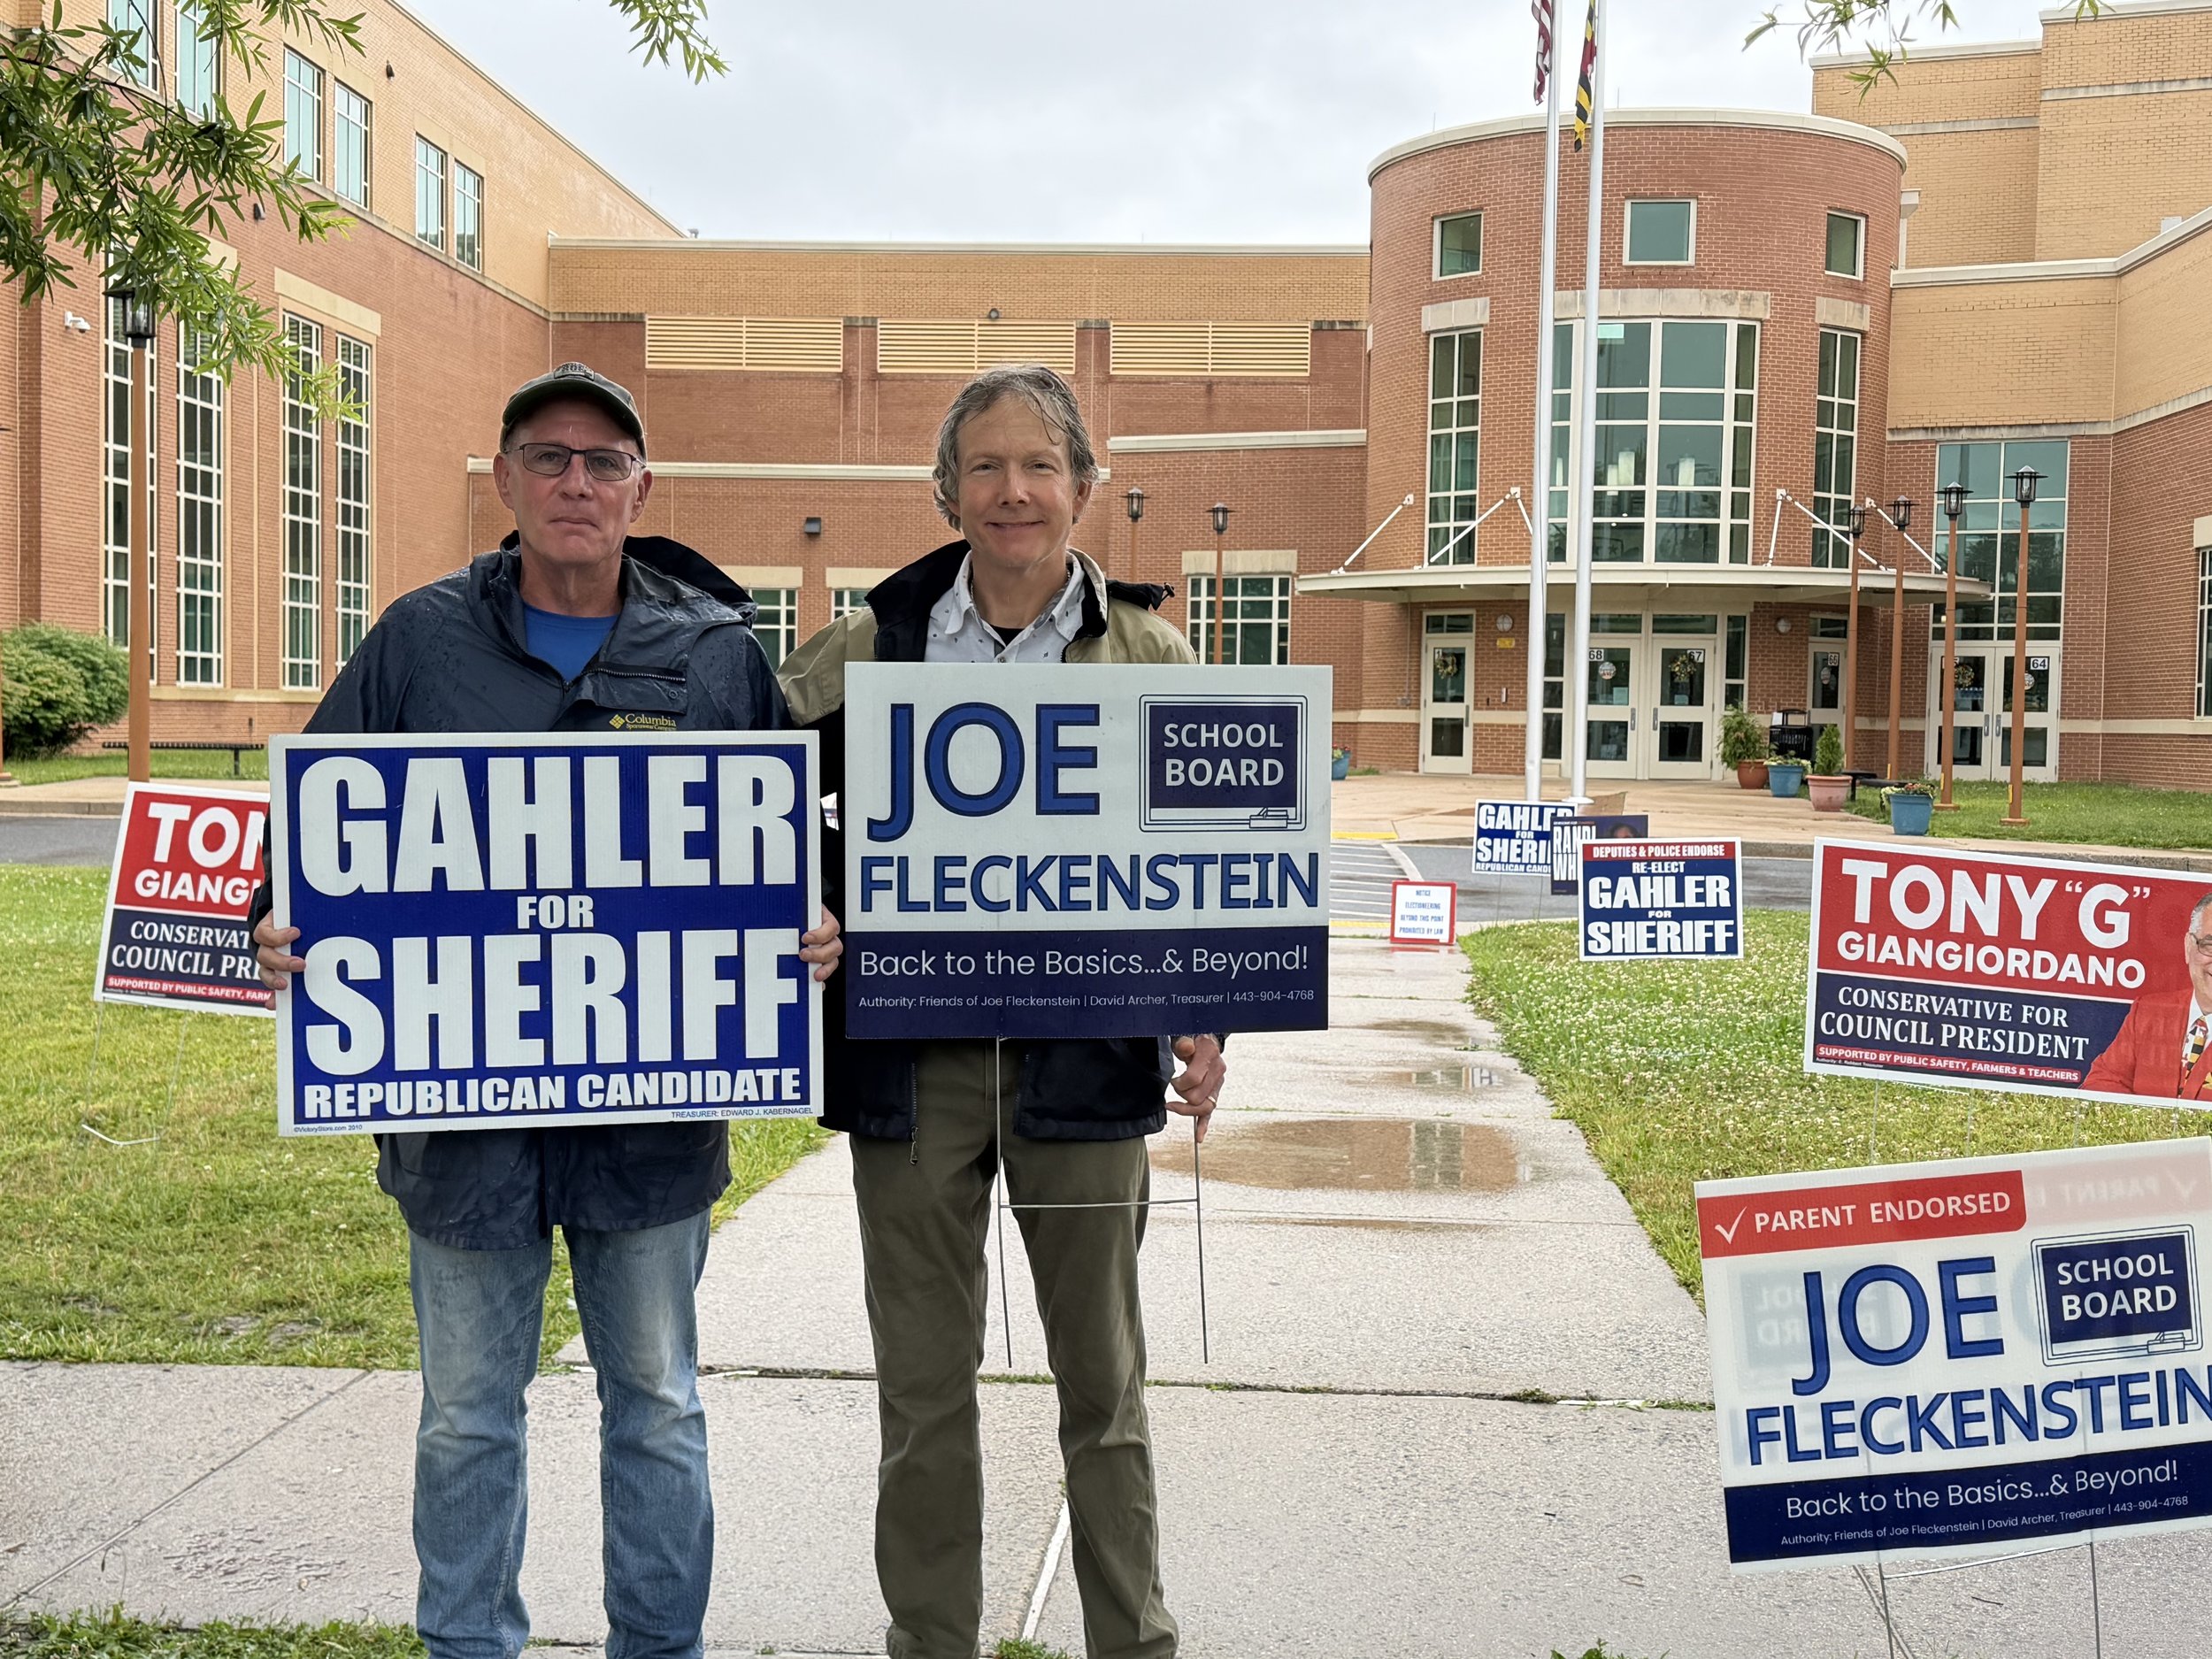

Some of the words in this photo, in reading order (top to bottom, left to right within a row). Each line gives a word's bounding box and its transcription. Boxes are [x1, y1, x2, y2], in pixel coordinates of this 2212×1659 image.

[1589, 650, 1602, 659] 68
[1689, 651, 1702, 661] 67
[2032, 659, 2047, 668] 64
[625, 713, 676, 726] Columbia
[1164, 722, 1284, 749] SCHOOL
[866, 702, 1101, 842] JOE
[1164, 758, 1285, 787] BOARD
[299, 755, 796, 896] GAHLER
[1476, 863, 1525, 872] REPUBLICAN
[1593, 846, 1637, 858] DEPUTIES
[1639, 845, 1647, 857] &
[1647, 845, 1680, 857] POLICE
[1682, 844, 1724, 856] ENDORSE
[1632, 862, 1686, 873] RE-ELECT
[860, 852, 1319, 912] FLECKENSTEIN
[1588, 875, 1732, 910] GAHLER
[517, 895, 594, 929] FOR
[1841, 858, 2057, 941] TONY
[1587, 920, 1735, 954] SHERIFF
[111, 944, 214, 976] COUNCIL
[861, 950, 936, 976] Back
[945, 951, 975, 975] to
[985, 949, 1035, 975] the
[1193, 945, 1308, 979] Beyond!
[1837, 931, 2146, 989] GIANGIORDANO
[108, 977, 159, 991] SUPPORTED
[162, 983, 173, 992] BY
[175, 984, 205, 995] PUBLIC
[208, 987, 244, 1000] SAFETY,
[305, 928, 800, 1076] SHERIFF
[859, 996, 917, 1010] Authority:
[919, 996, 963, 1007] Friends
[966, 996, 979, 1006] of
[981, 996, 1002, 1006] Joe
[1006, 996, 1080, 1007] Fleckenstein
[1090, 995, 1124, 1006] David
[1127, 994, 1168, 1006] Archer,
[1171, 994, 1224, 1004] Treasurer
[1233, 990, 1314, 1002] 443-904-4768
[1838, 986, 2013, 1023] CONSERVATIVE
[2021, 1003, 2069, 1028] FOR
[1820, 1011, 1933, 1047] COUNCIL
[1940, 1023, 2089, 1061] PRESIDENT
[1819, 1047, 1877, 1061] SUPPORTED
[1879, 1053, 1892, 1063] BY
[1893, 1054, 1928, 1066] PUBLIC
[1930, 1058, 1970, 1071] SAFETY,
[1972, 1062, 2016, 1075] FARMERS
[2028, 1068, 2078, 1081] TEACHERS
[304, 1075, 566, 1118] REPUBLICAN
[577, 1067, 801, 1107] CANDIDATE
[1755, 1203, 1856, 1233] PARENT
[1870, 1191, 2011, 1224] ENDORSED
[2056, 1252, 2174, 1286] SCHOOL
[2062, 1284, 2177, 1322] BOARD
[1792, 1256, 2005, 1396] JOE
[1746, 1365, 2212, 1466] FLECKENSTEIN
[1786, 1492, 1853, 1518] Back
[1859, 1492, 1886, 1511] to
[1894, 1486, 1939, 1509] the
[2075, 1460, 2177, 1494] Beyond!
[1781, 1532, 1832, 1545] Authority:
[1834, 1529, 1873, 1540] Friends
[1876, 1527, 1886, 1537] of
[1889, 1525, 1909, 1536] Joe
[1911, 1520, 1978, 1534] Fleckenstein
[1988, 1517, 2018, 1529] David
[2021, 1512, 2058, 1525] Archer,
[2060, 1506, 2105, 1521] Treasurer
[2114, 1495, 2189, 1513] 443-904-4768
